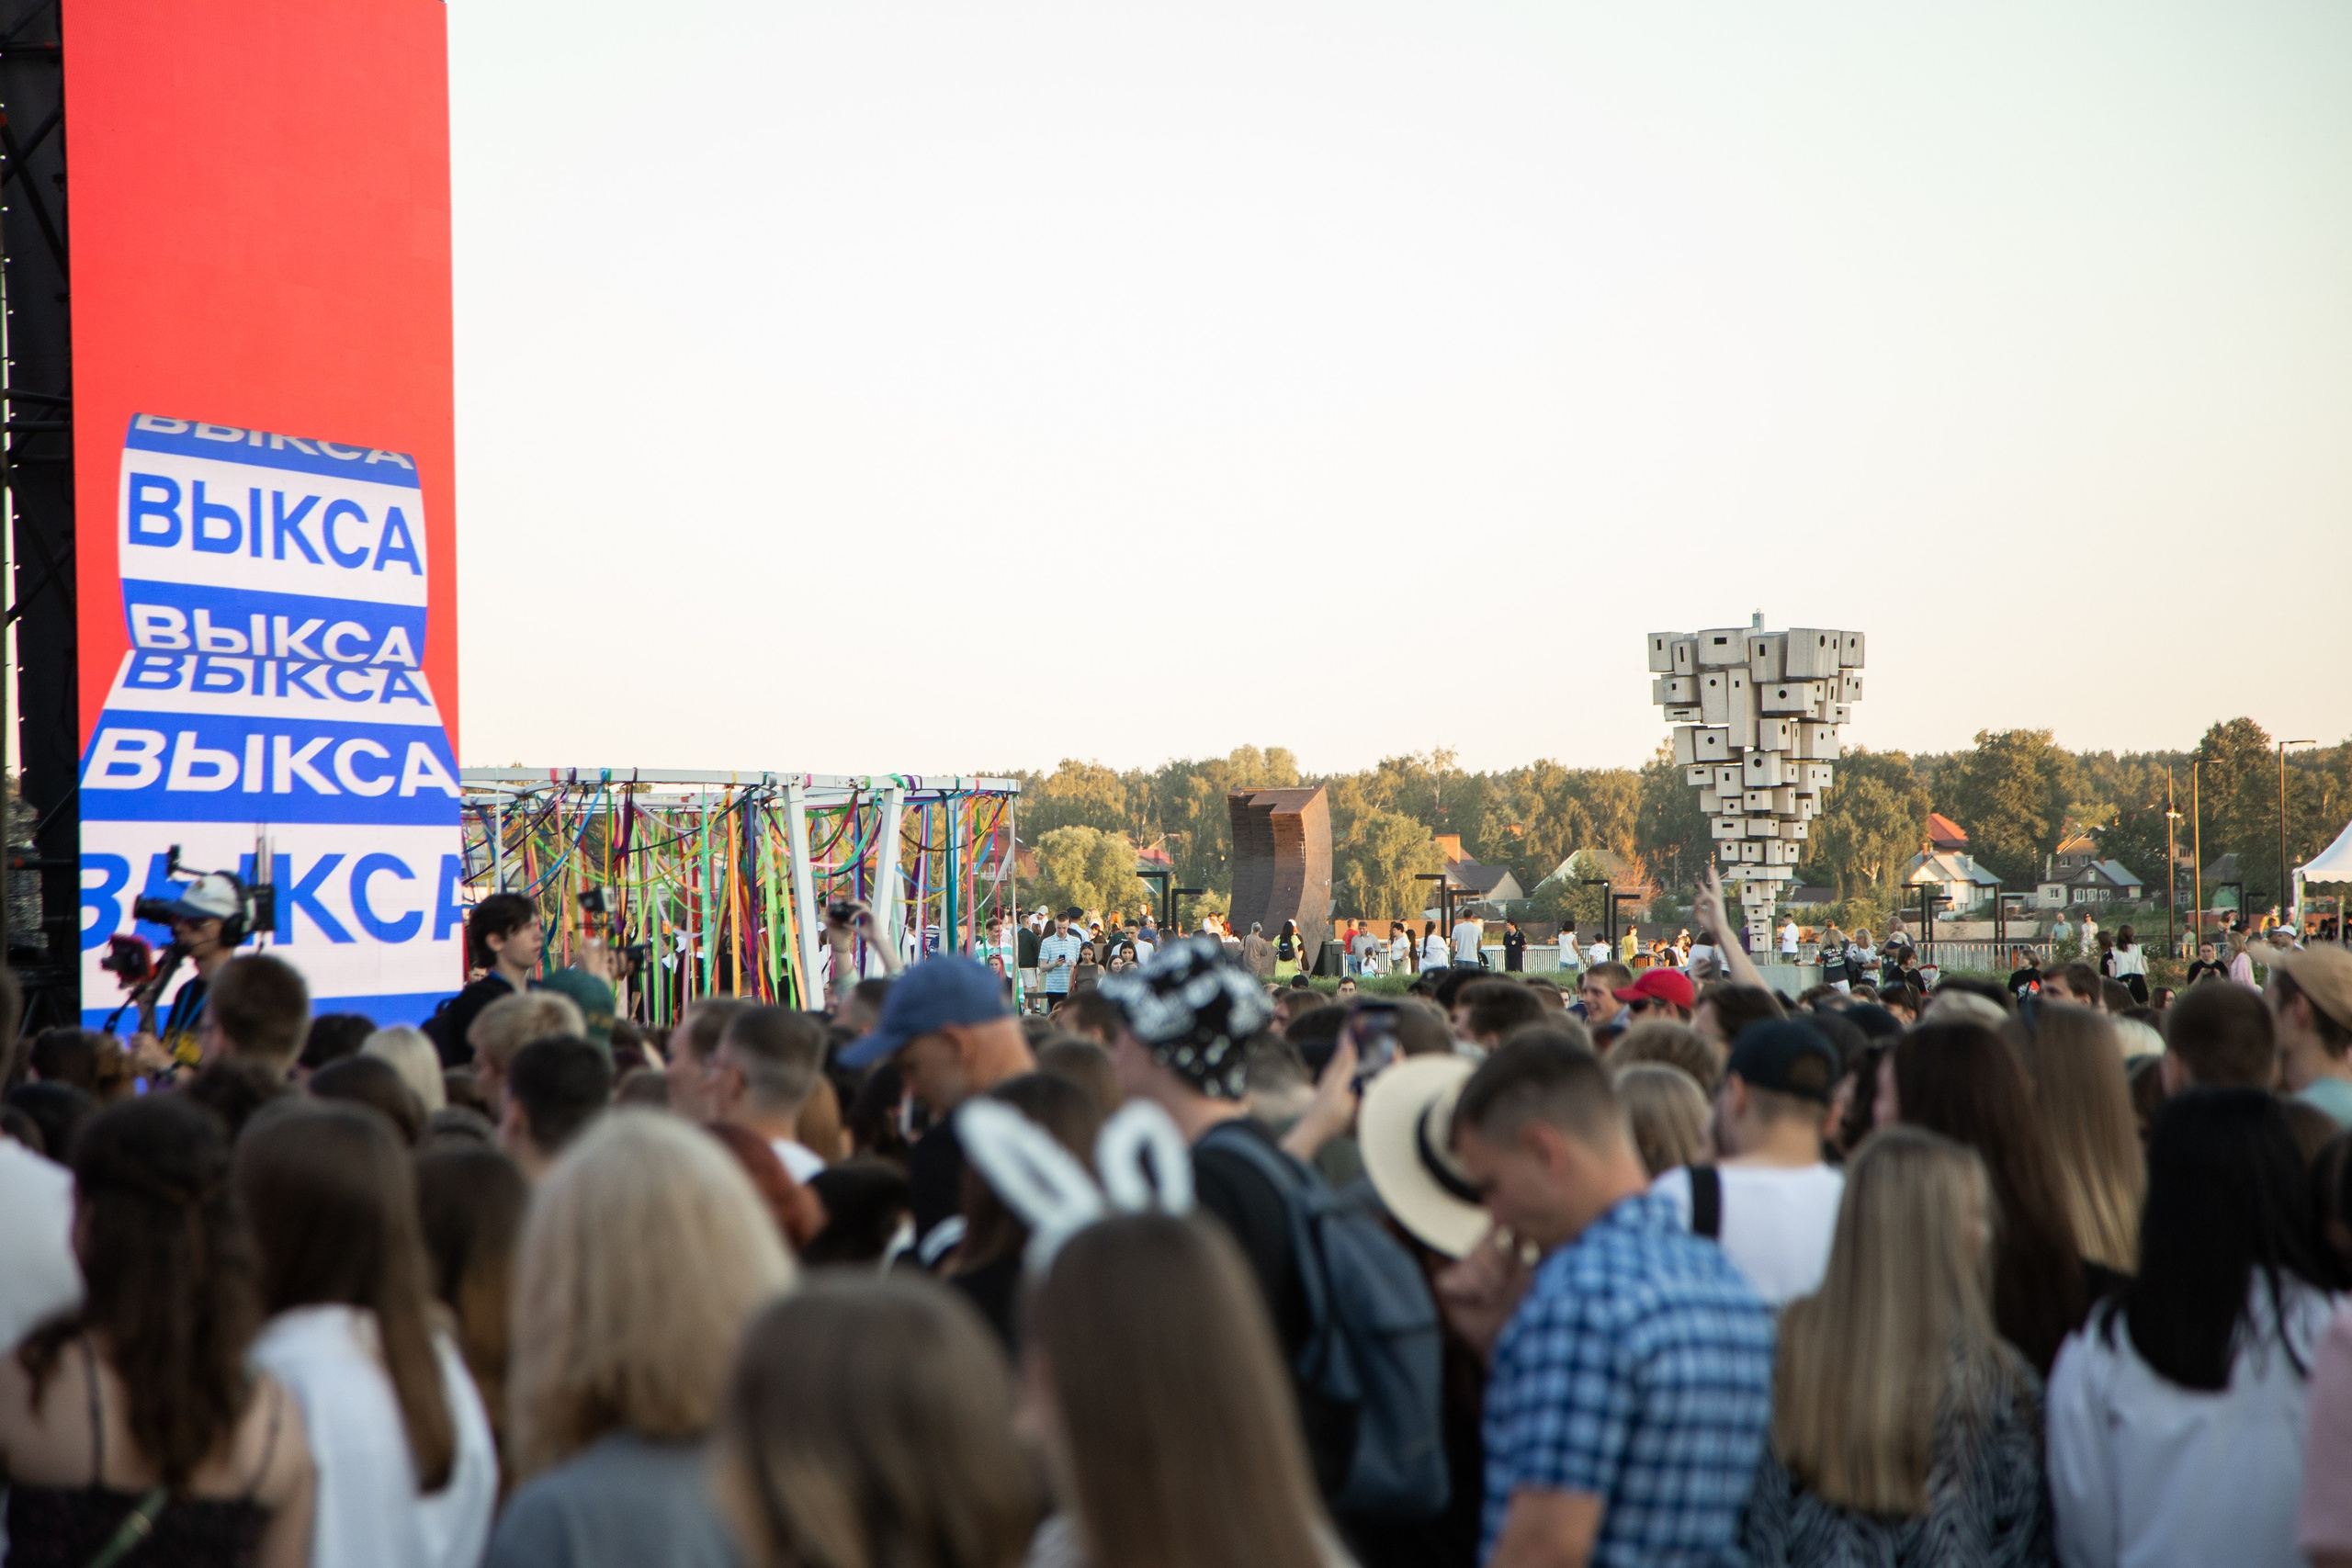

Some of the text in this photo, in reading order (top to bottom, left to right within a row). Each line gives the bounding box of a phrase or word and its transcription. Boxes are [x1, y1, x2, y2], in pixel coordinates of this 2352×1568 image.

[129, 472, 424, 576] ВЫКСА
[130, 604, 418, 667] ВЫКСА
[122, 653, 433, 706] ВЫКСА
[80, 728, 459, 798] ВЫКСА
